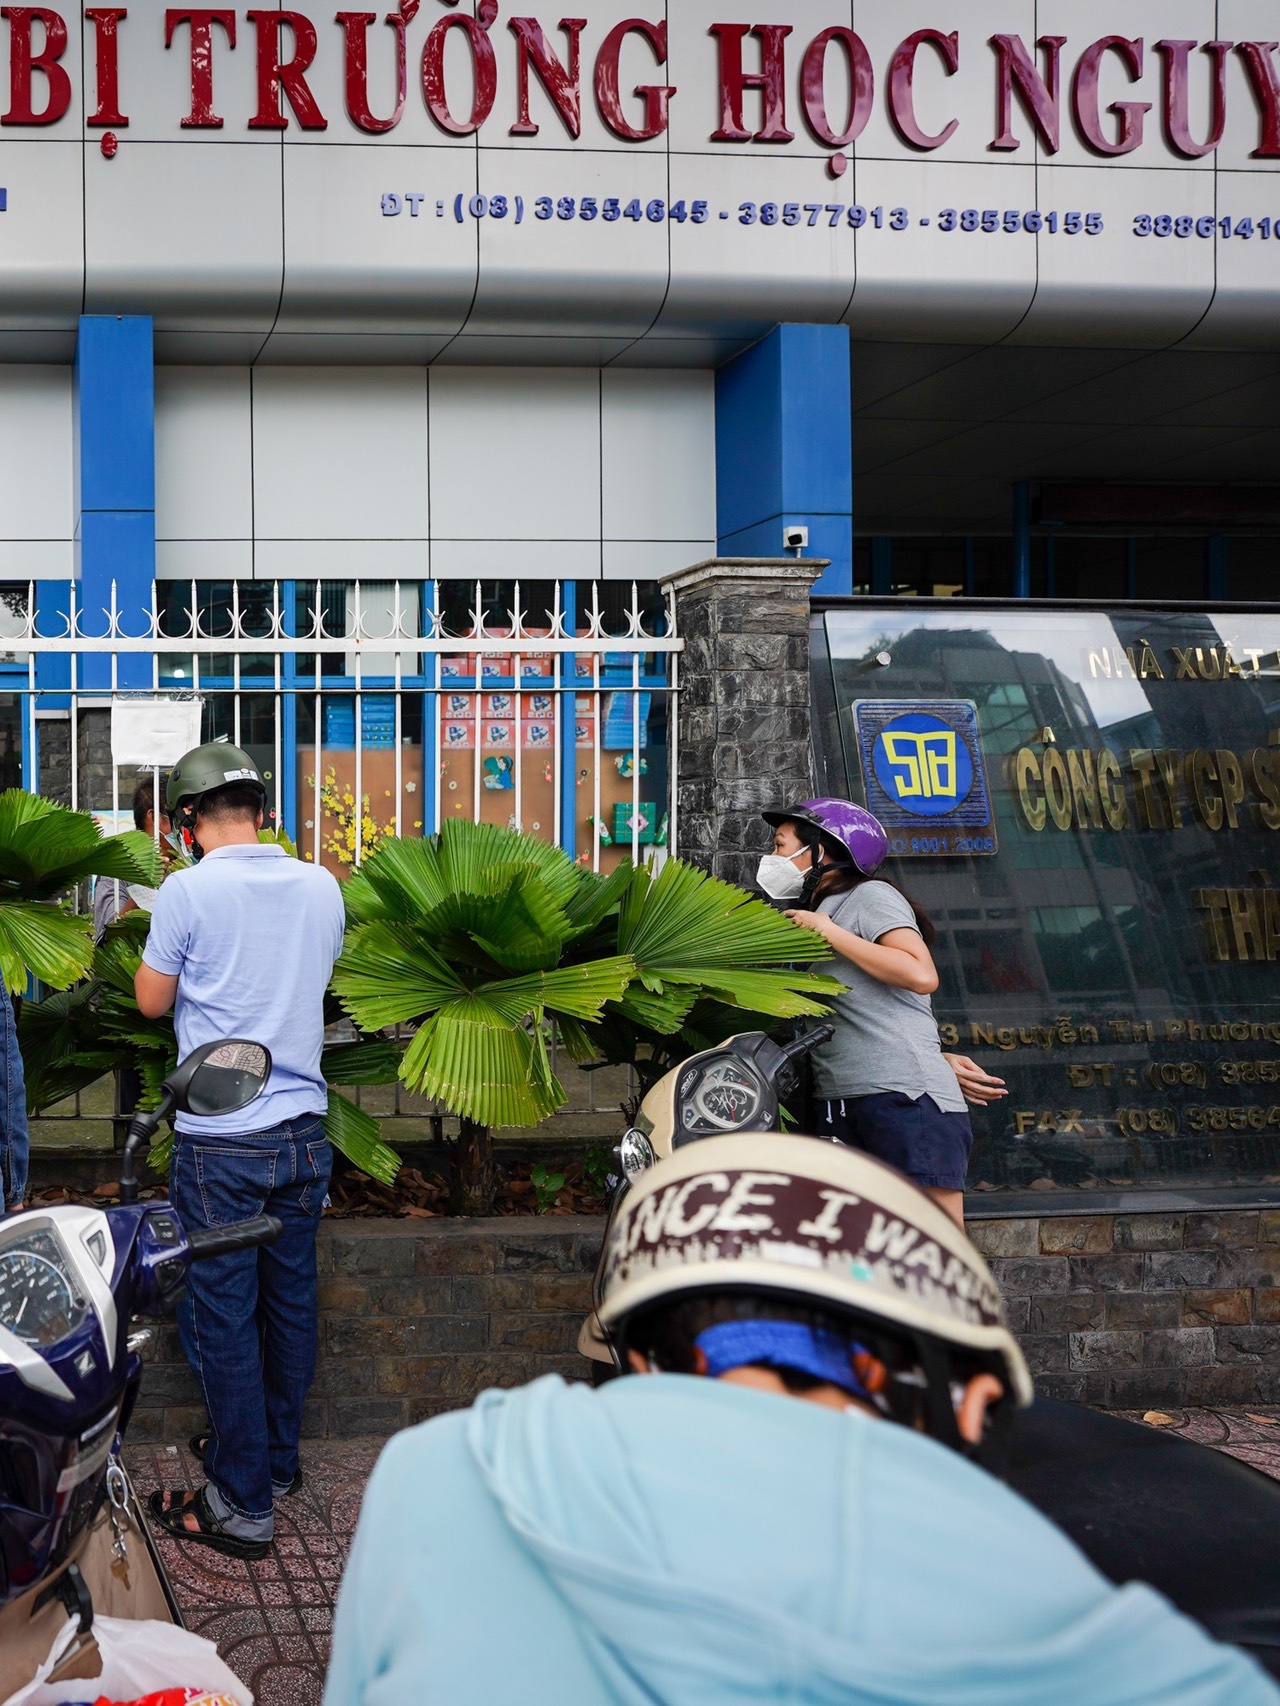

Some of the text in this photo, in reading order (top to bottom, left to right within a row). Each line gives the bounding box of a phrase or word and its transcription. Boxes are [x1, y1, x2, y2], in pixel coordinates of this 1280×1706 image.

[0, 6, 129, 159] BỊ
[708, 22, 959, 180] HỌC
[738, 202, 910, 231] 38577913
[938, 208, 1105, 235] 38556155
[1088, 638, 1165, 680] NHÀ
[1014, 726, 1126, 831] CÔNG
[1129, 748, 1184, 830] TY
[1190, 746, 1245, 831] CP
[969, 1016, 1100, 1051] Nguyễn
[1107, 1020, 1155, 1042] Tri
[1149, 1060, 1209, 1091] (08)
[1220, 1060, 1280, 1085] 385
[1116, 1107, 1180, 1137] (08)
